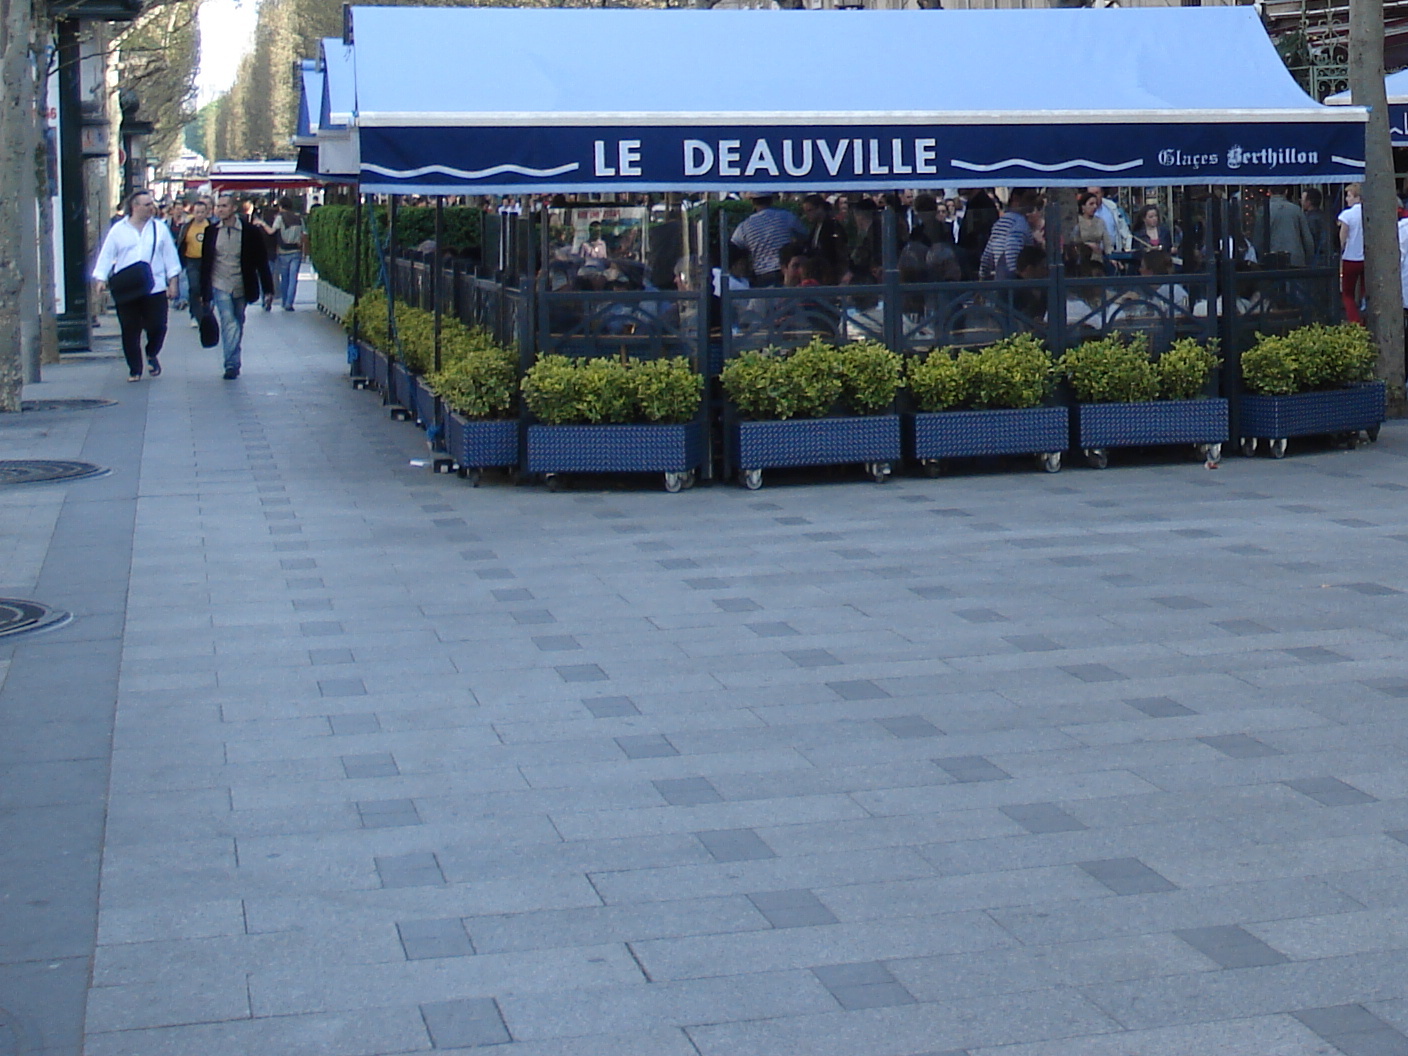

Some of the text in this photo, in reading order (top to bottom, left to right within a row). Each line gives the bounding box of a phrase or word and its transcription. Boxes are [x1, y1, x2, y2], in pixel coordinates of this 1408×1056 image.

[593, 138, 937, 176] LE DEAUVILLE
[1226, 144, 1319, 170] Berthillon
